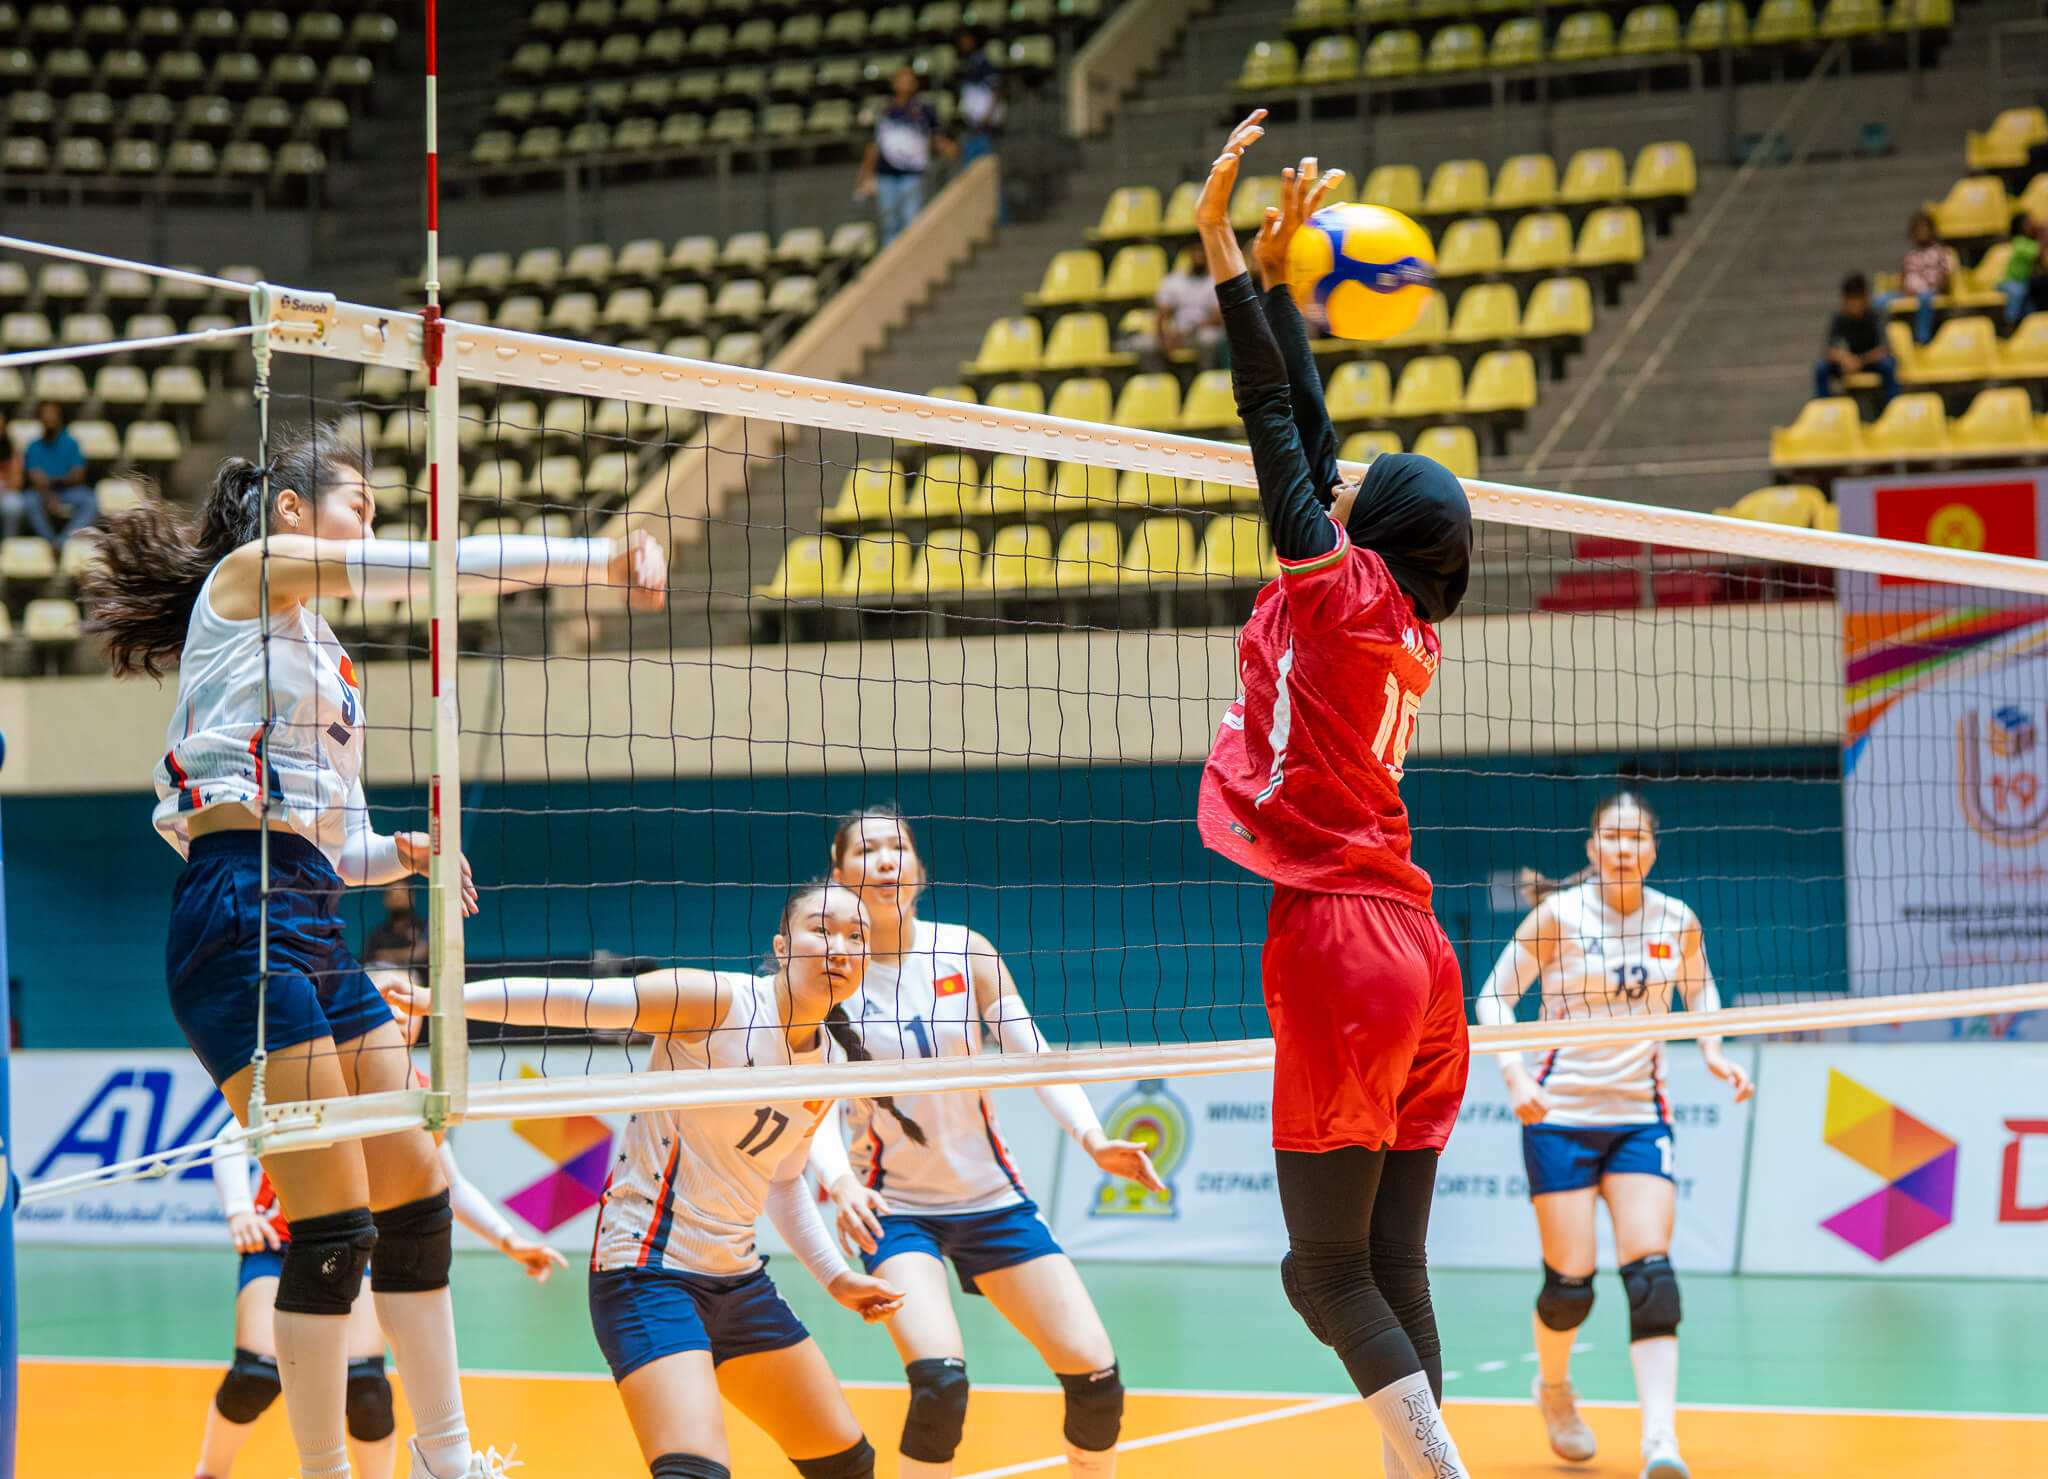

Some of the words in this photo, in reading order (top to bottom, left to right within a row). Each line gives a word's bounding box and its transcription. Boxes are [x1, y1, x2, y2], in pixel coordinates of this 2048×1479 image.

[291, 298, 328, 315] Senoh
[335, 673, 356, 727] 9
[1612, 965, 1648, 1000] 13
[903, 1015, 932, 1059] 1
[735, 1106, 790, 1157] 17
[1206, 1103, 1268, 1121] MINIS
